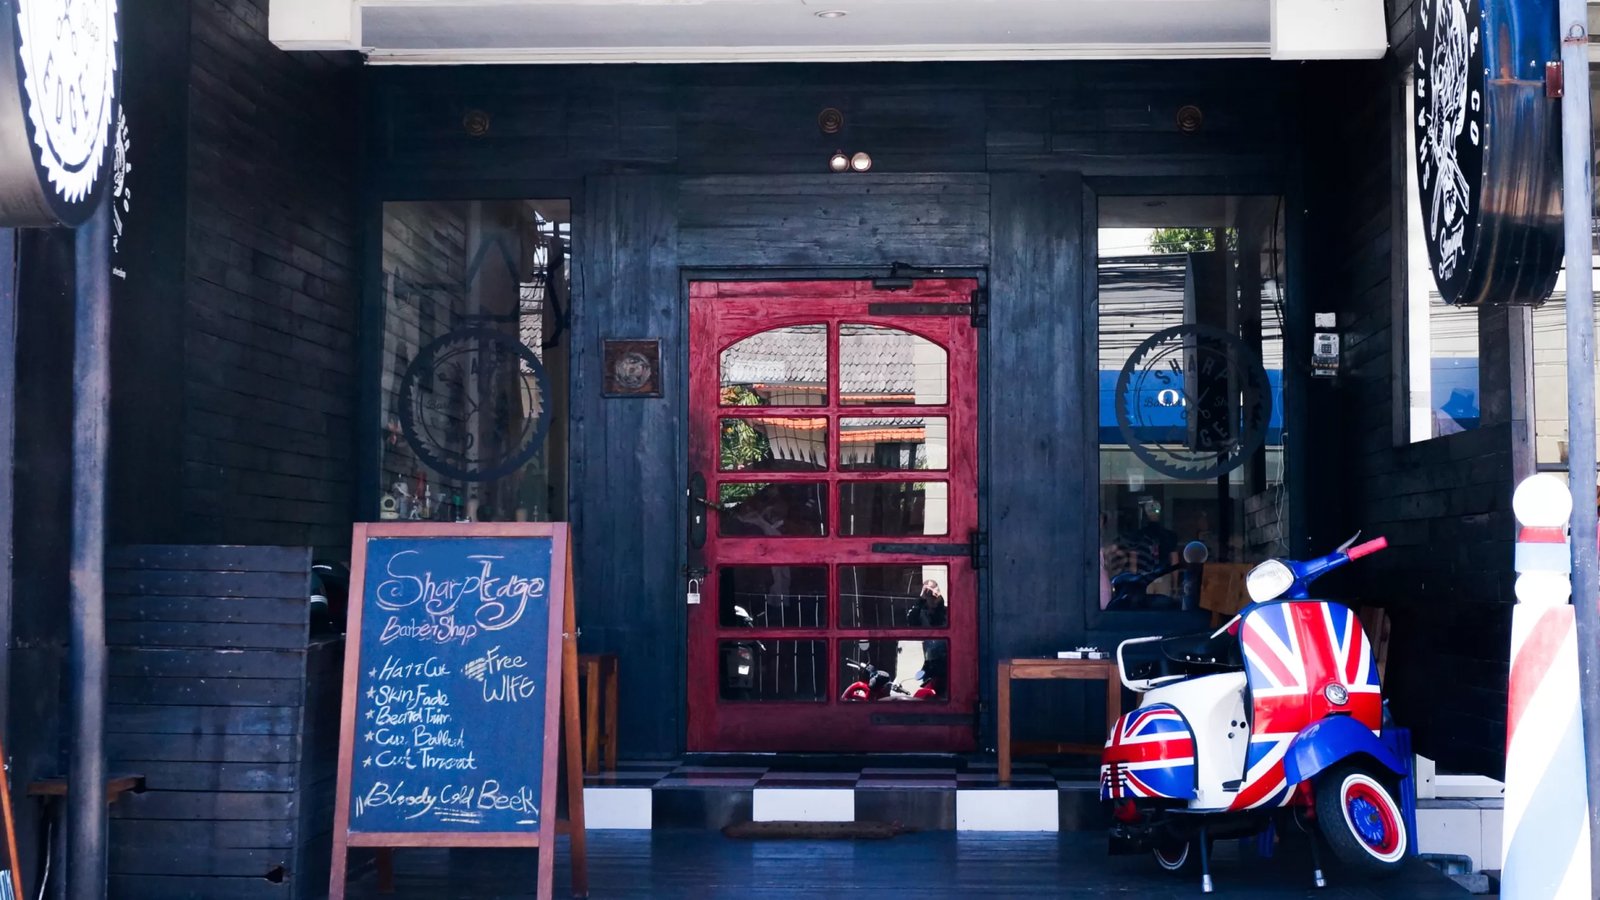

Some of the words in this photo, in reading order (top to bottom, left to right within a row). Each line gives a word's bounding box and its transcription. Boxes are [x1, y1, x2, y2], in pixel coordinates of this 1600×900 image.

[43, 50, 90, 135] EDGE
[1417, 47, 1430, 190] SHARP
[376, 550, 480, 615] Sharp
[487, 645, 528, 674] Free
[364, 781, 437, 820] Bloody
[440, 784, 475, 809] Cold
